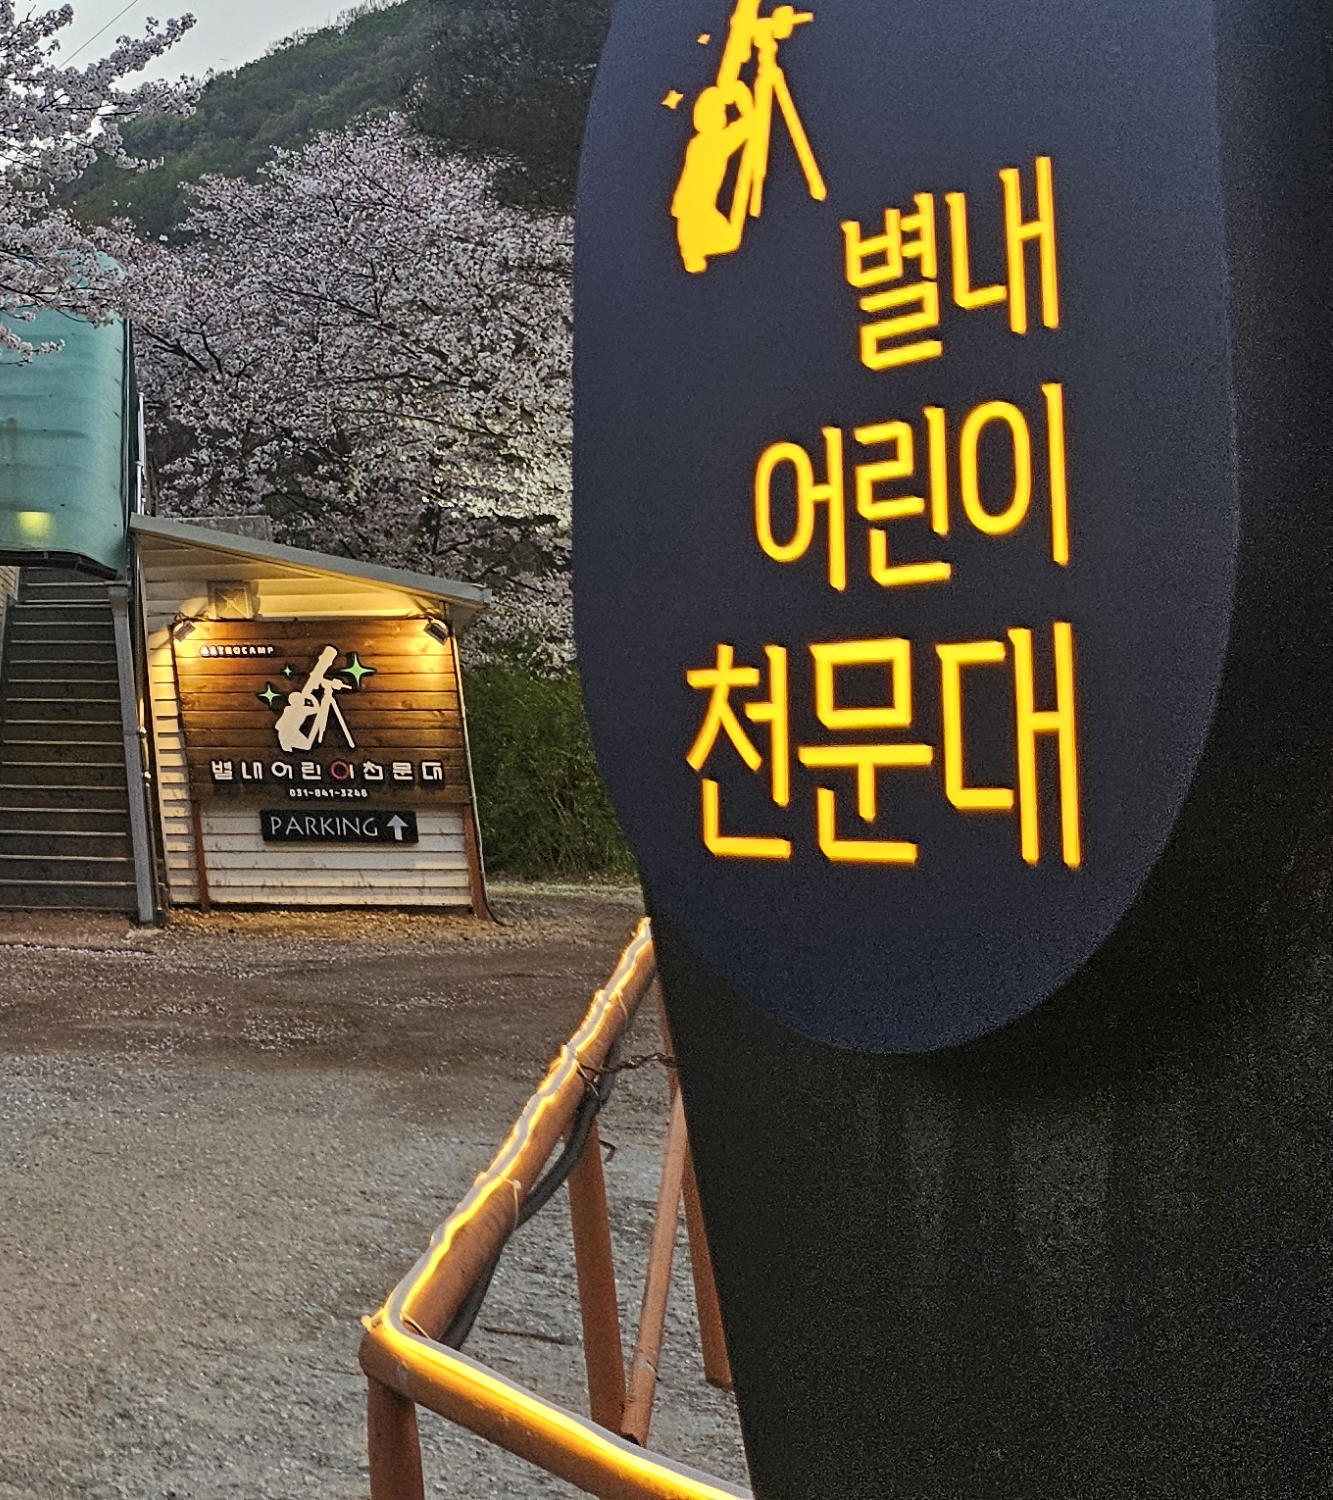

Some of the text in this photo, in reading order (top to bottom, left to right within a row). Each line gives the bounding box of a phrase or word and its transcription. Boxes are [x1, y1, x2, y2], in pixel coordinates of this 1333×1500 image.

[840, 155, 1062, 372] 별내
[753, 381, 1071, 593] 어린이
[270, 815, 379, 837] PARKING
[685, 621, 1082, 869] 천문대
